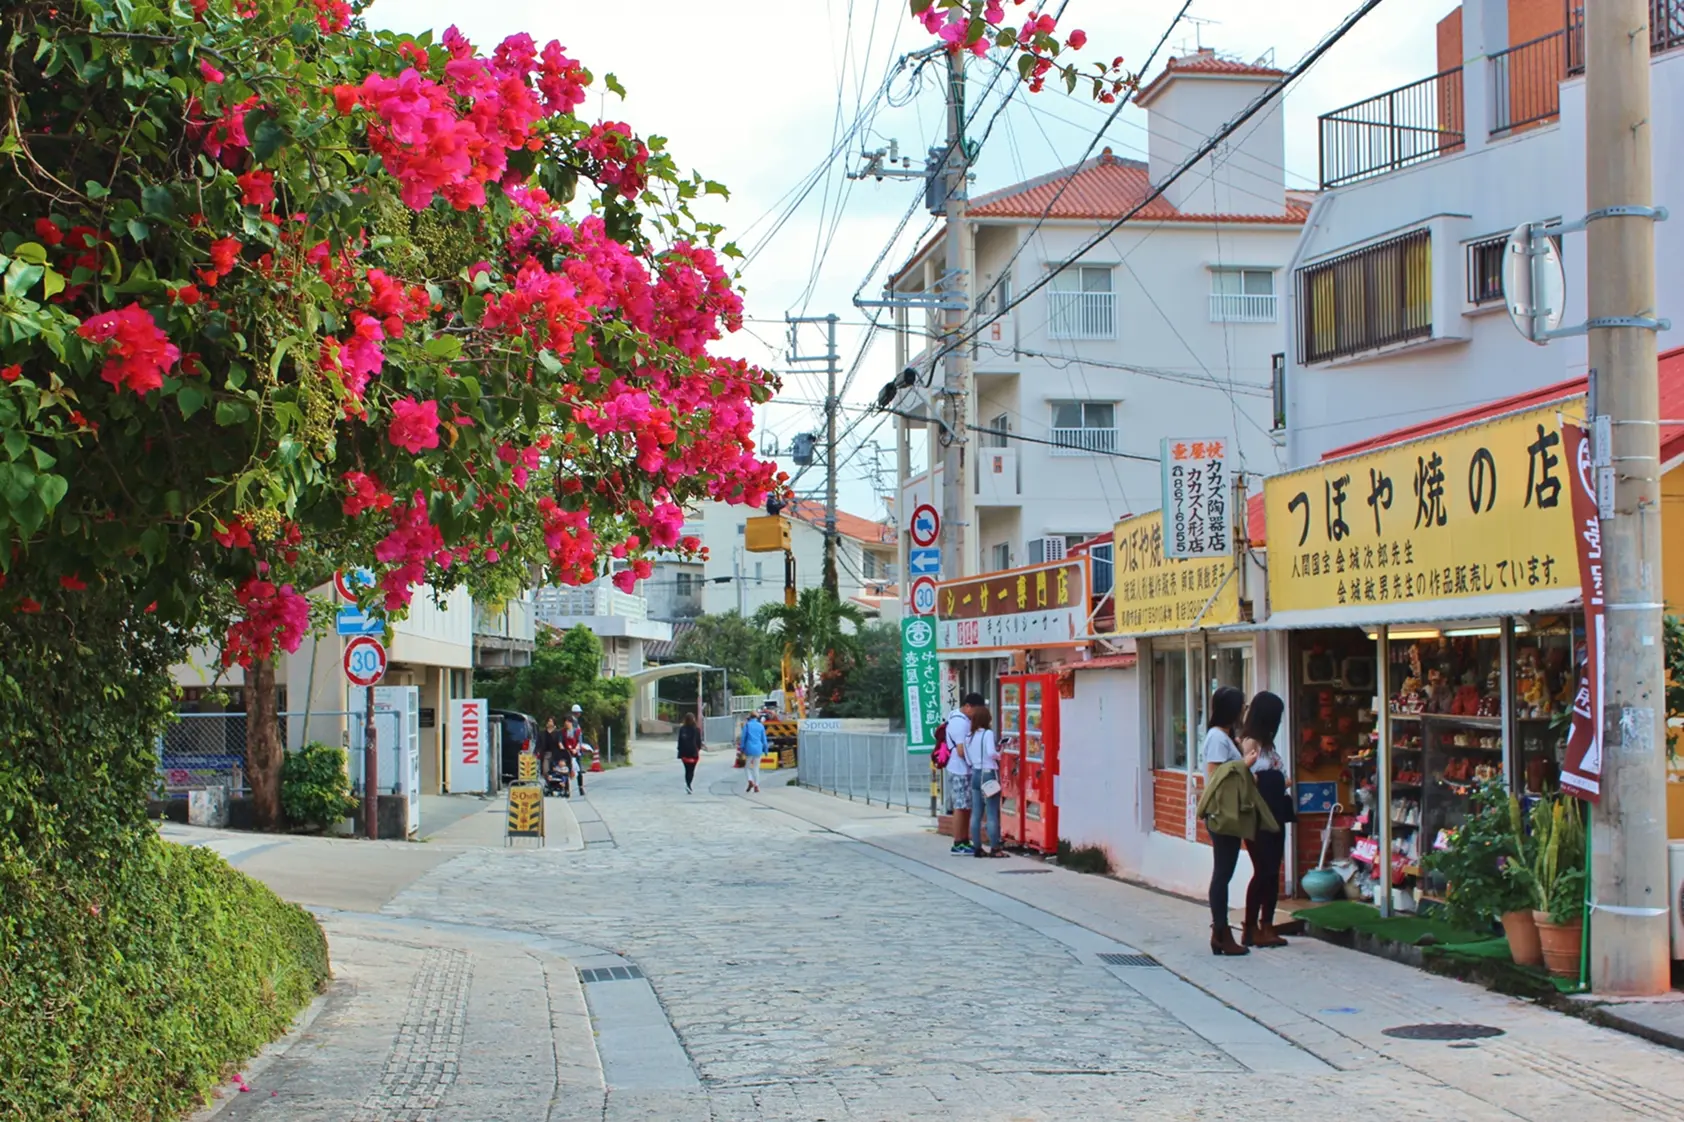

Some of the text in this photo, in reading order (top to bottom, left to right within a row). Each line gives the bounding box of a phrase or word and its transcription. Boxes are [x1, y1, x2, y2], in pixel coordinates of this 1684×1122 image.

[1187, 467, 1205, 553] カカズ人形店
[1206, 459, 1226, 552] カカズ陶器店
[1288, 424, 1561, 547] つぼや焼の店
[1174, 478, 1186, 552] 867-6055
[1120, 522, 1188, 574] つぼや焼
[917, 588, 934, 608] 30
[947, 567, 1069, 617] シーサー専門店
[352, 650, 377, 673] 30
[462, 703, 479, 764] KIRIN
[804, 720, 840, 730] Sprout
